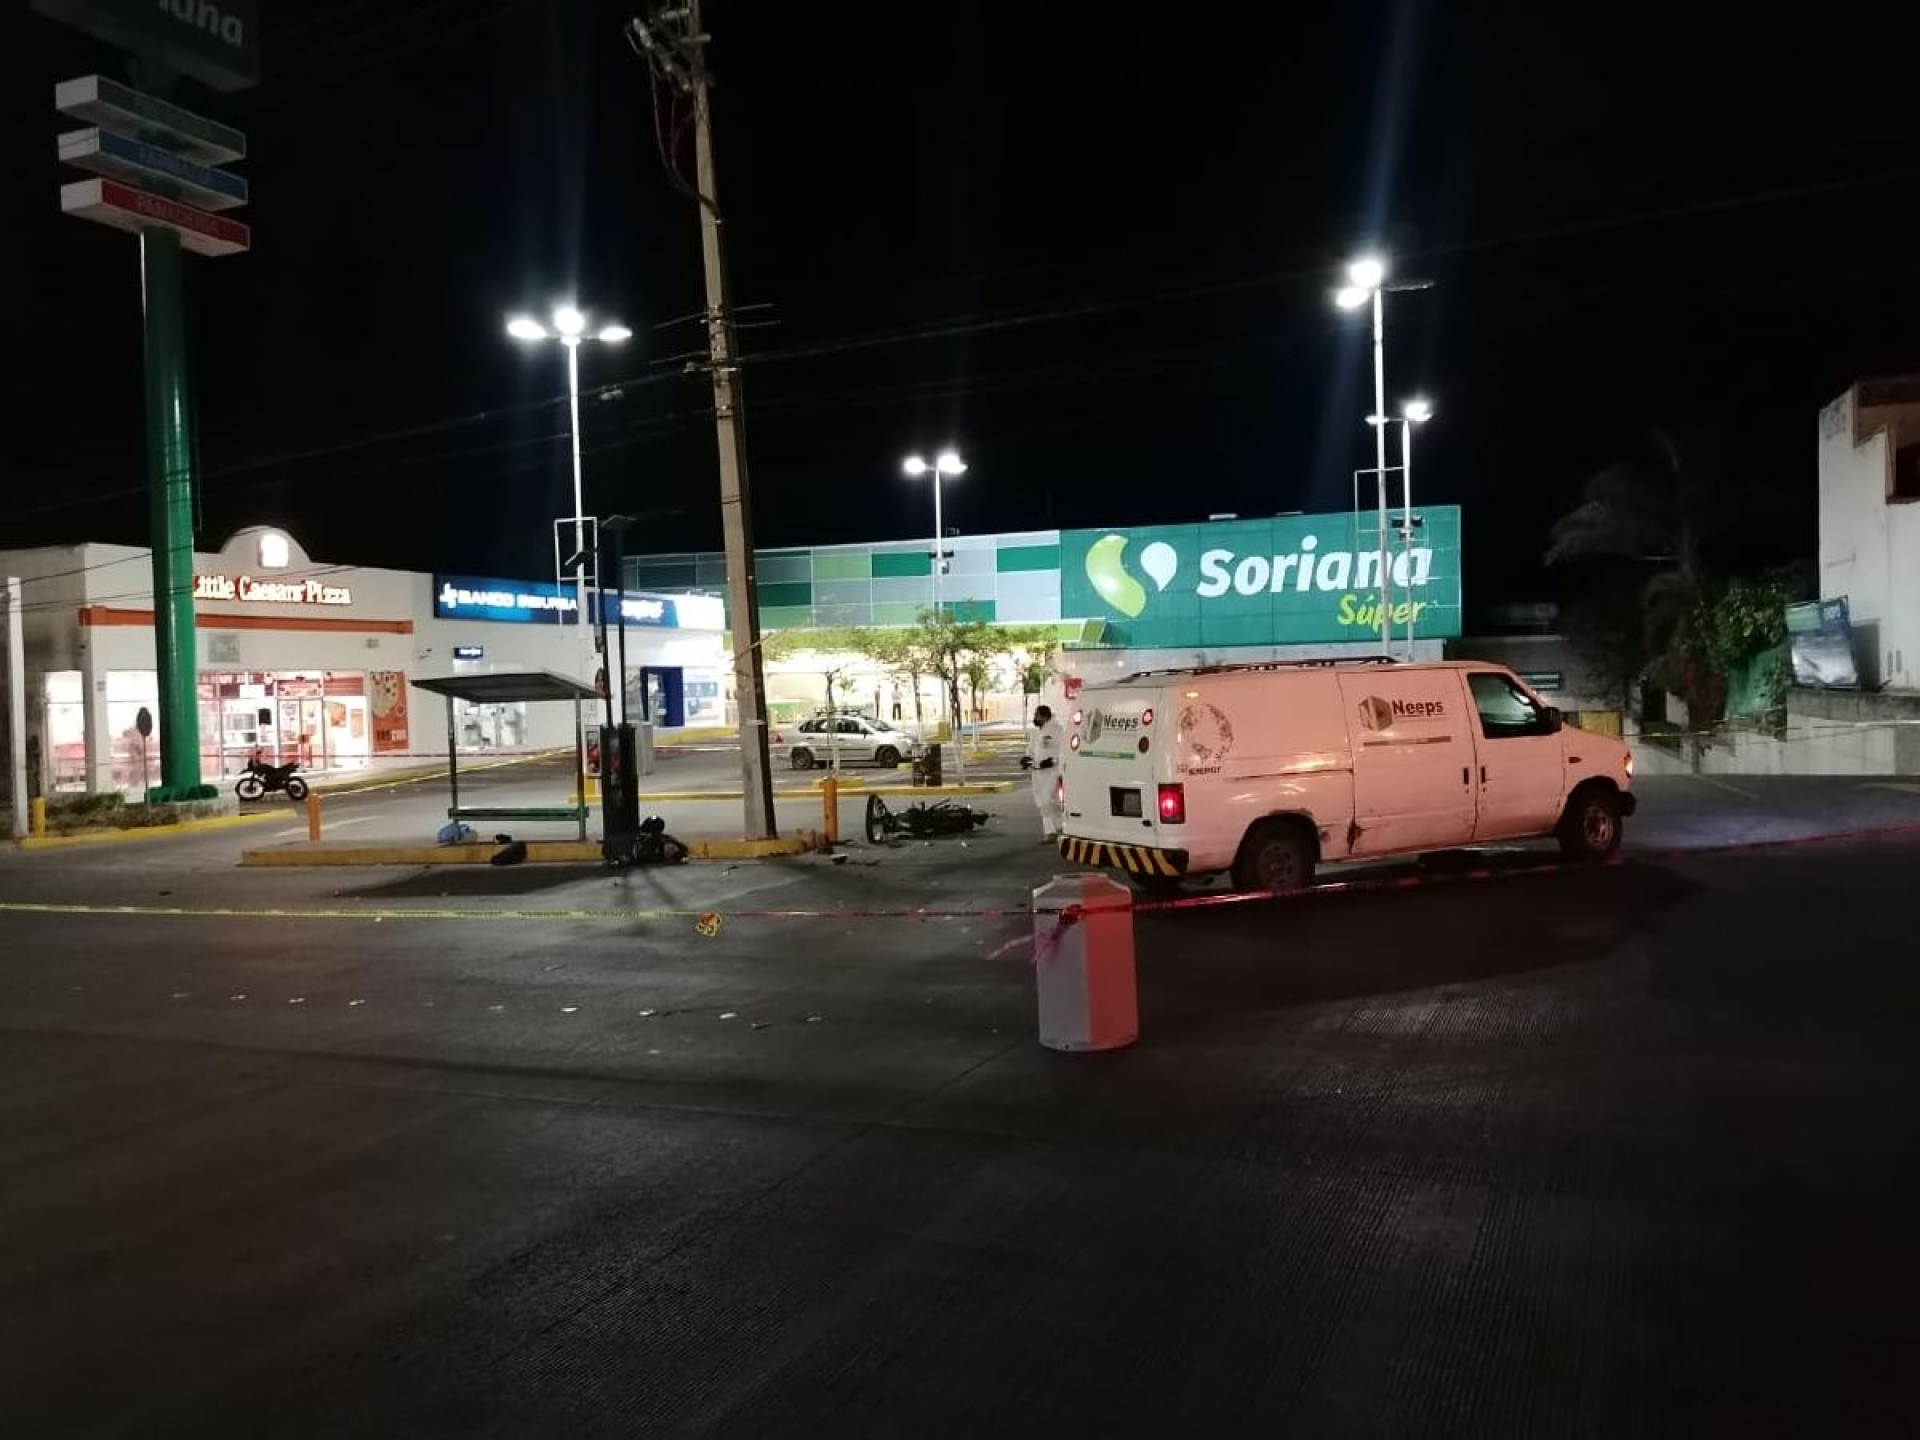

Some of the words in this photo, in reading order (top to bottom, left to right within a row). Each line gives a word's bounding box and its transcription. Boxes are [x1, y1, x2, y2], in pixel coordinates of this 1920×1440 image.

[1197, 535, 1433, 598] Soriana
[306, 580, 352, 604] Pizza
[1337, 593, 1427, 633] Súper
[1391, 699, 1444, 717] Neeps
[1104, 714, 1139, 731] Neeps
